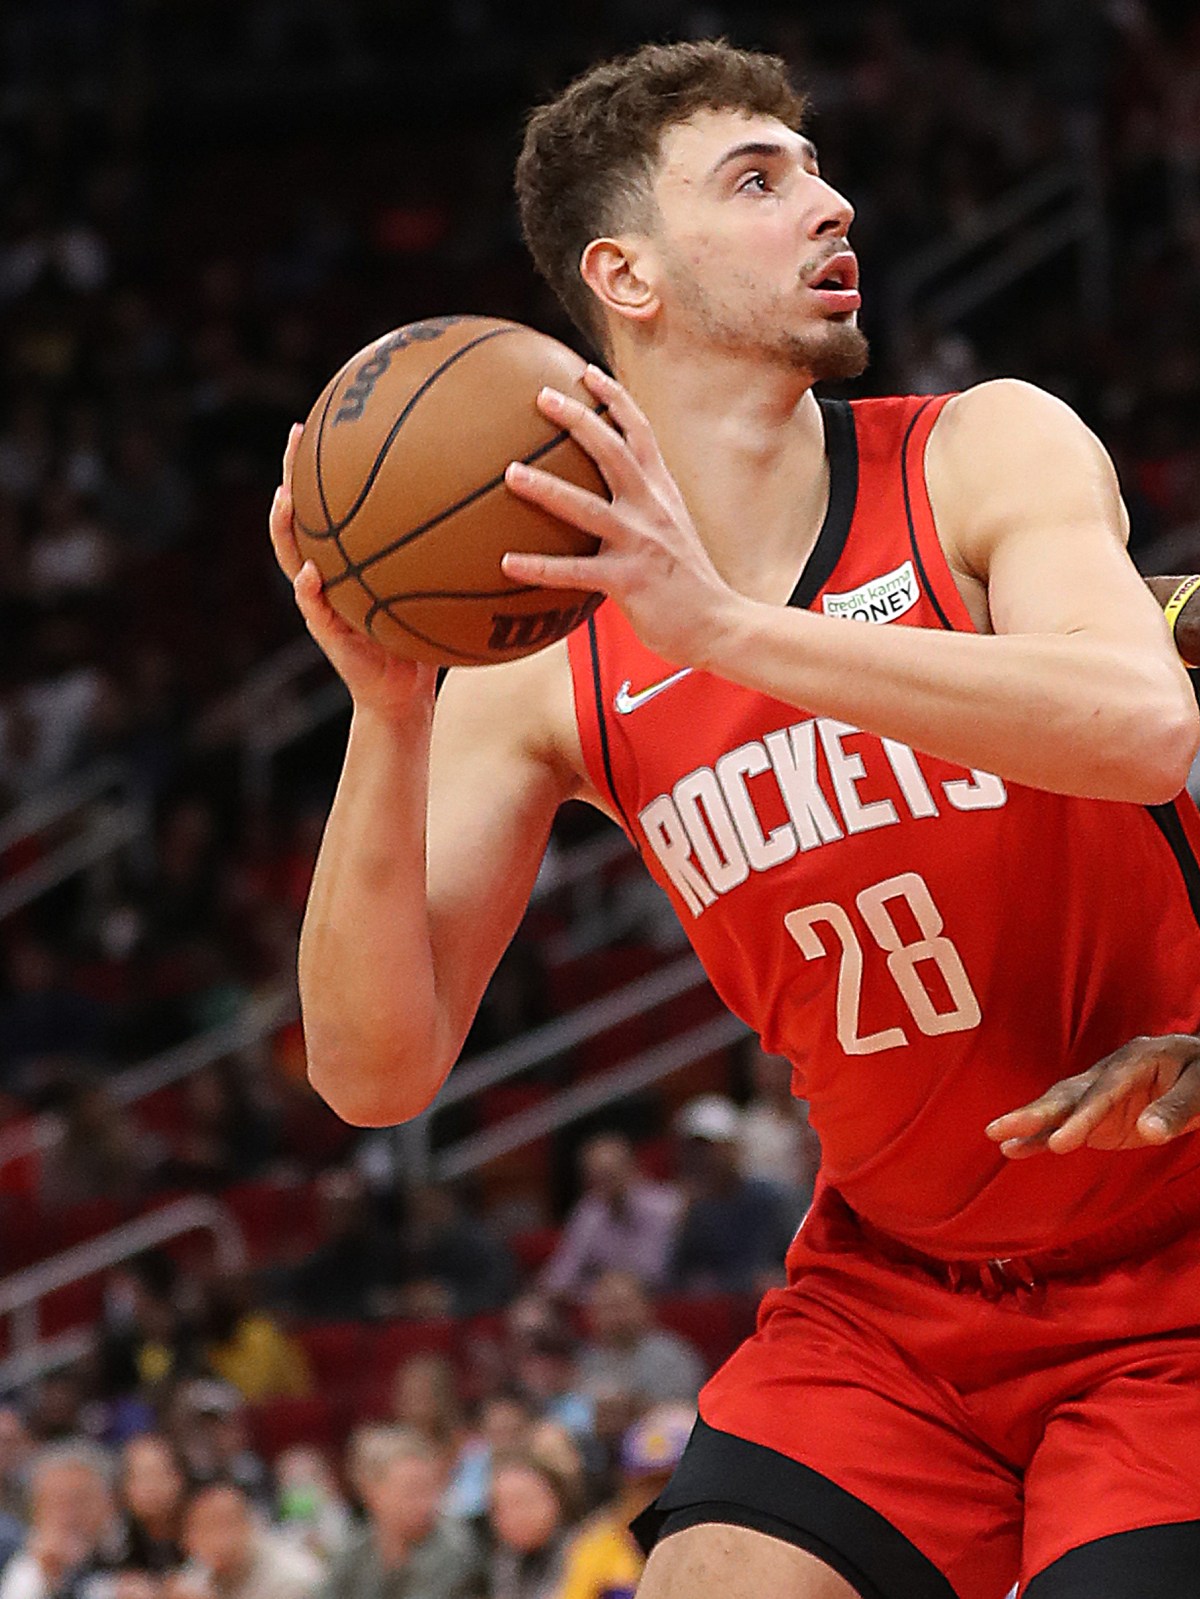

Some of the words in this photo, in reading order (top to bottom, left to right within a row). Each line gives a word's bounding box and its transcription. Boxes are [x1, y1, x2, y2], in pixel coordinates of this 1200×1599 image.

[827, 594, 868, 613] credit
[867, 570, 911, 600] karma
[829, 581, 912, 623] ONEY
[784, 872, 982, 1055] 28
